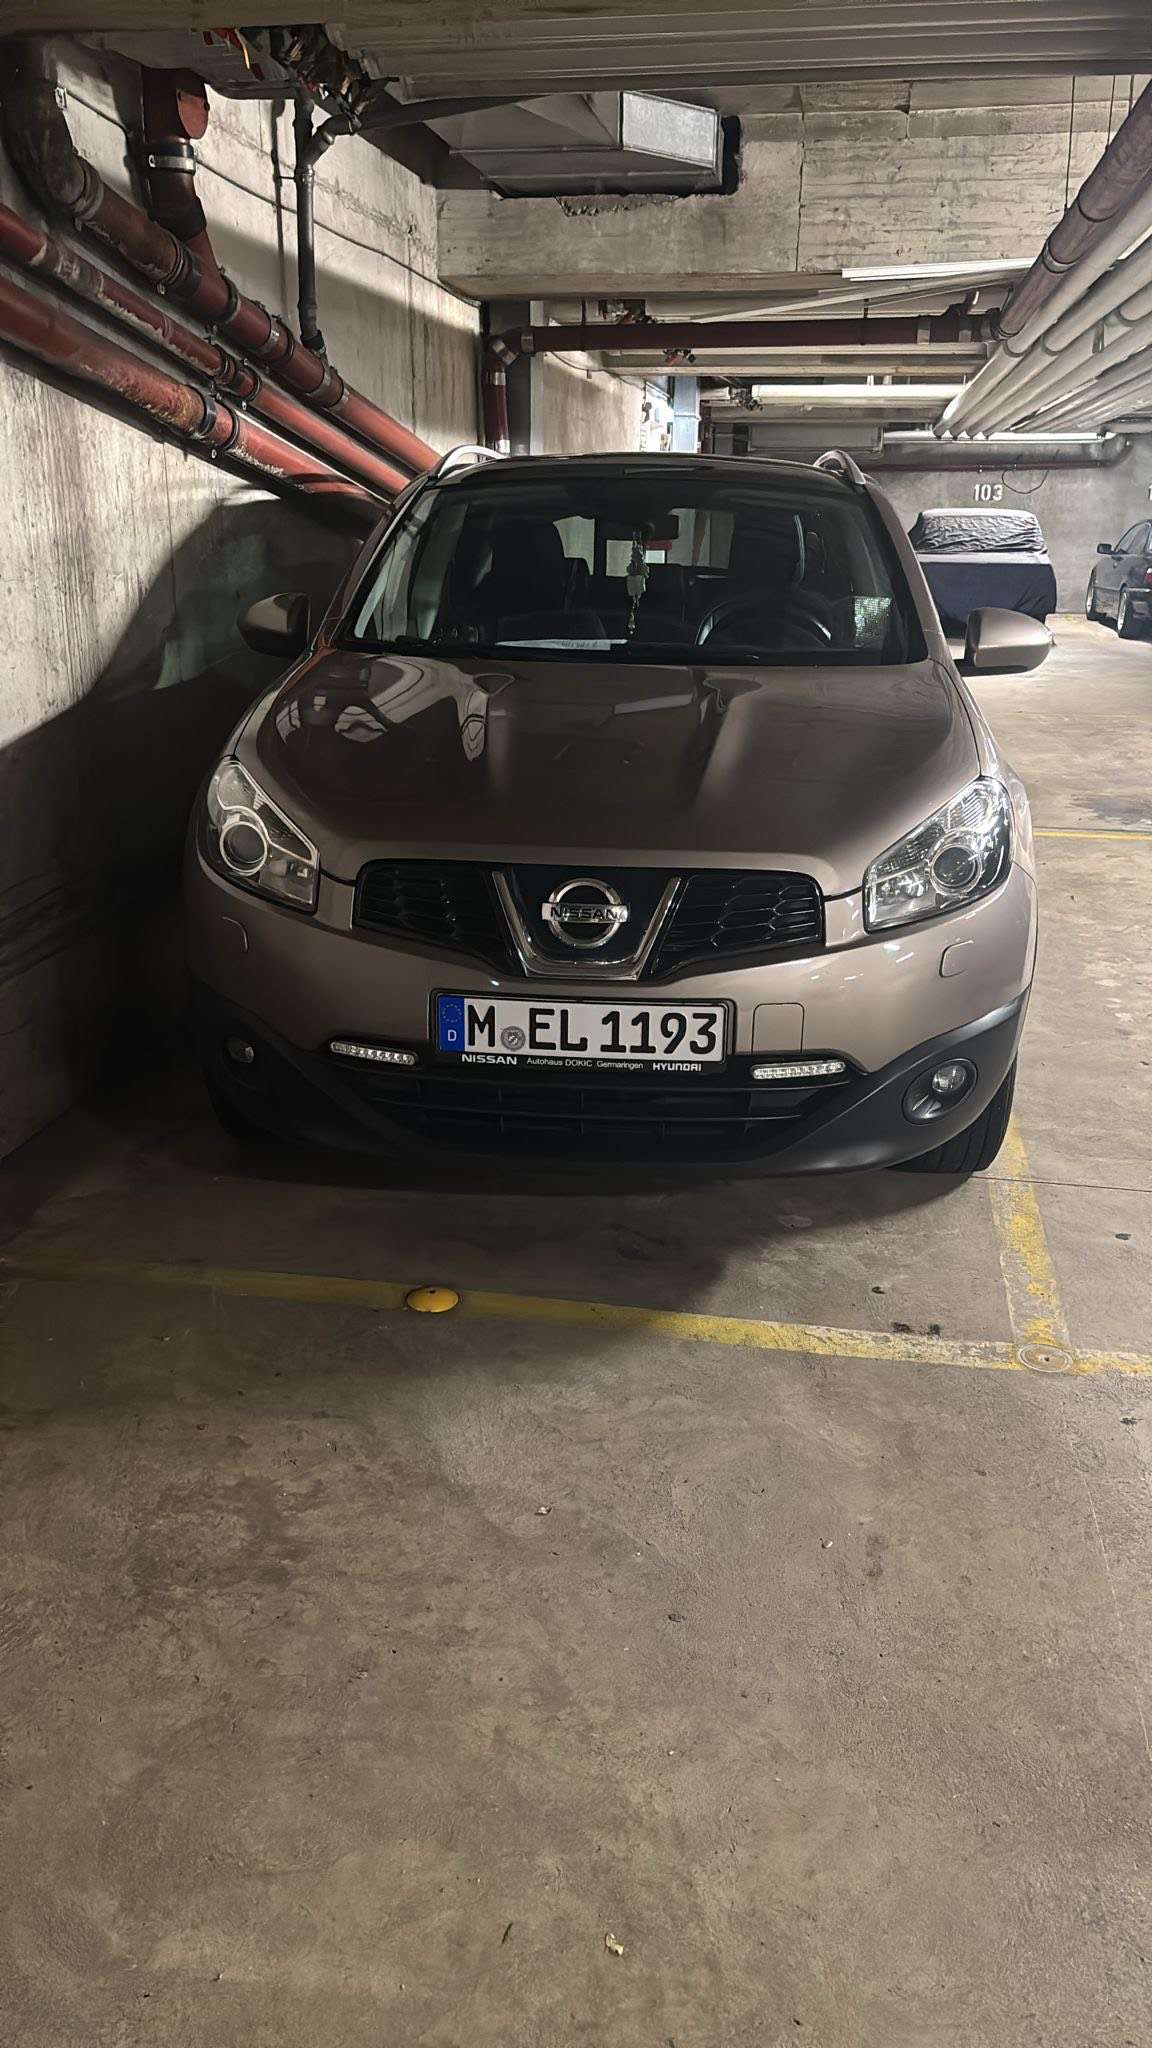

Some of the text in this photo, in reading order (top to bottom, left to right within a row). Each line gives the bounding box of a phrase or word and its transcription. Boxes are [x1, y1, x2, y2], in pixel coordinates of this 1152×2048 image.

[974, 484, 1003, 501] 103
[447, 1029, 457, 1042] D
[467, 1005, 717, 1055] M EL 1193
[461, 1054, 518, 1065] NISSAN
[526, 1057, 563, 1066] Autohaus
[596, 1060, 644, 1070] Germaringen
[652, 1062, 702, 1072] HYUNDAI
